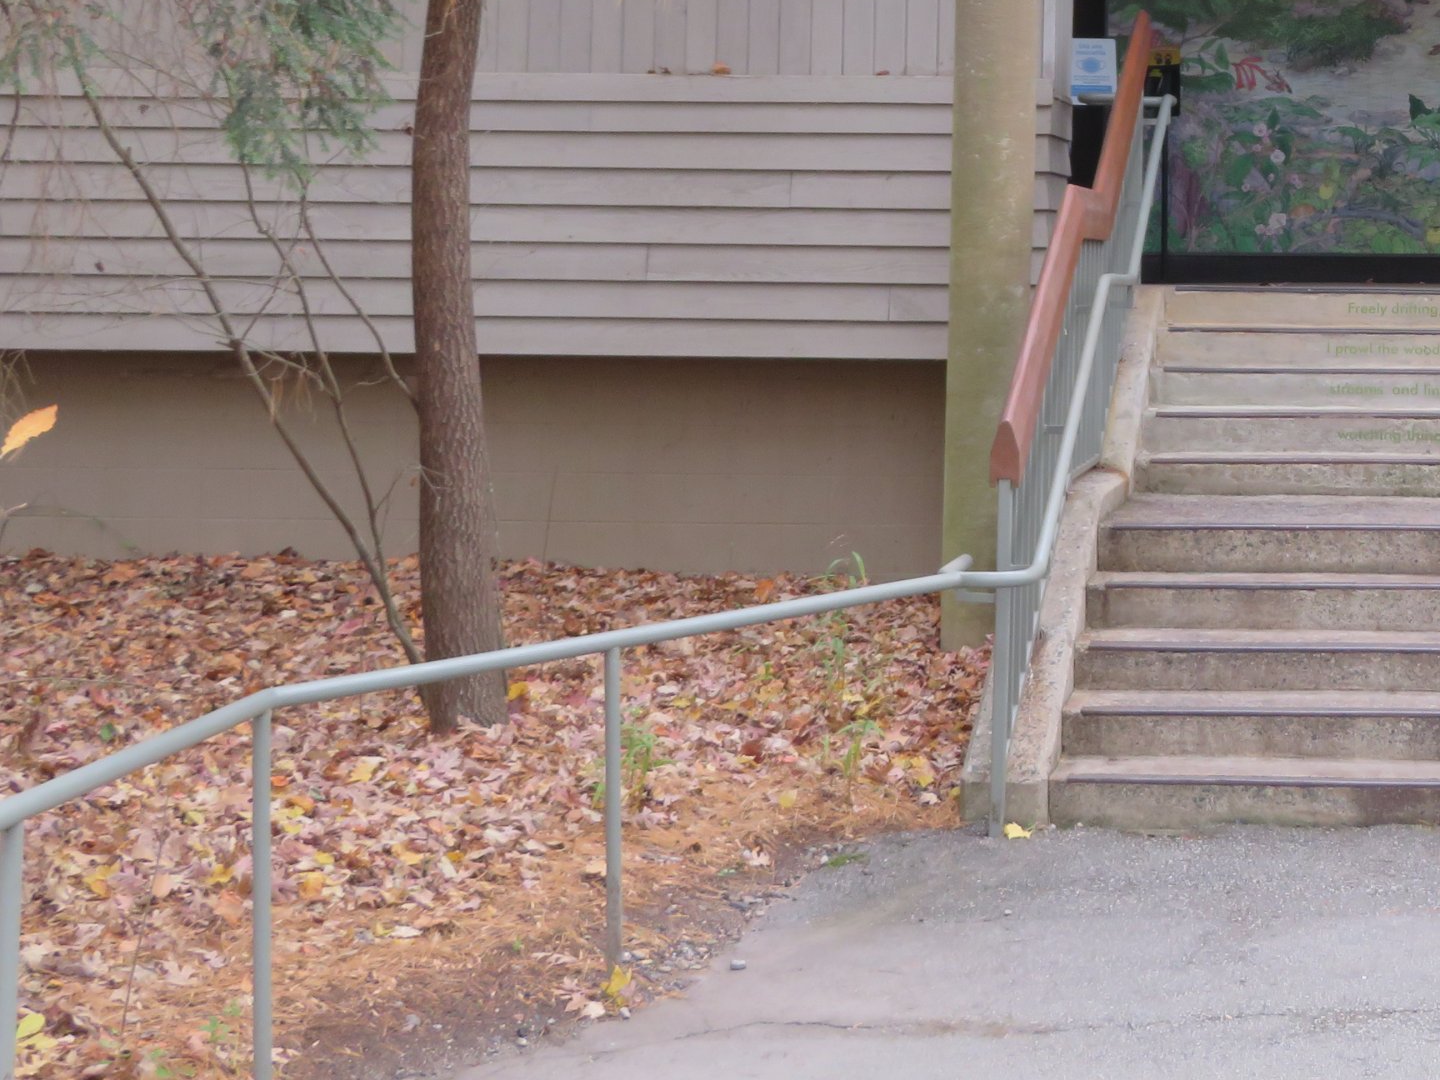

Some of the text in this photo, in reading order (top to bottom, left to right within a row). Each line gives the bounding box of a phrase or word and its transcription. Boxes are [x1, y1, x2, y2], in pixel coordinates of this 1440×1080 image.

[1347, 302, 1387, 317] Freely
[1335, 341, 1373, 357] prowl
[1377, 341, 1400, 354] the
[1329, 383, 1384, 396] streams
[1392, 382, 1419, 395] and
